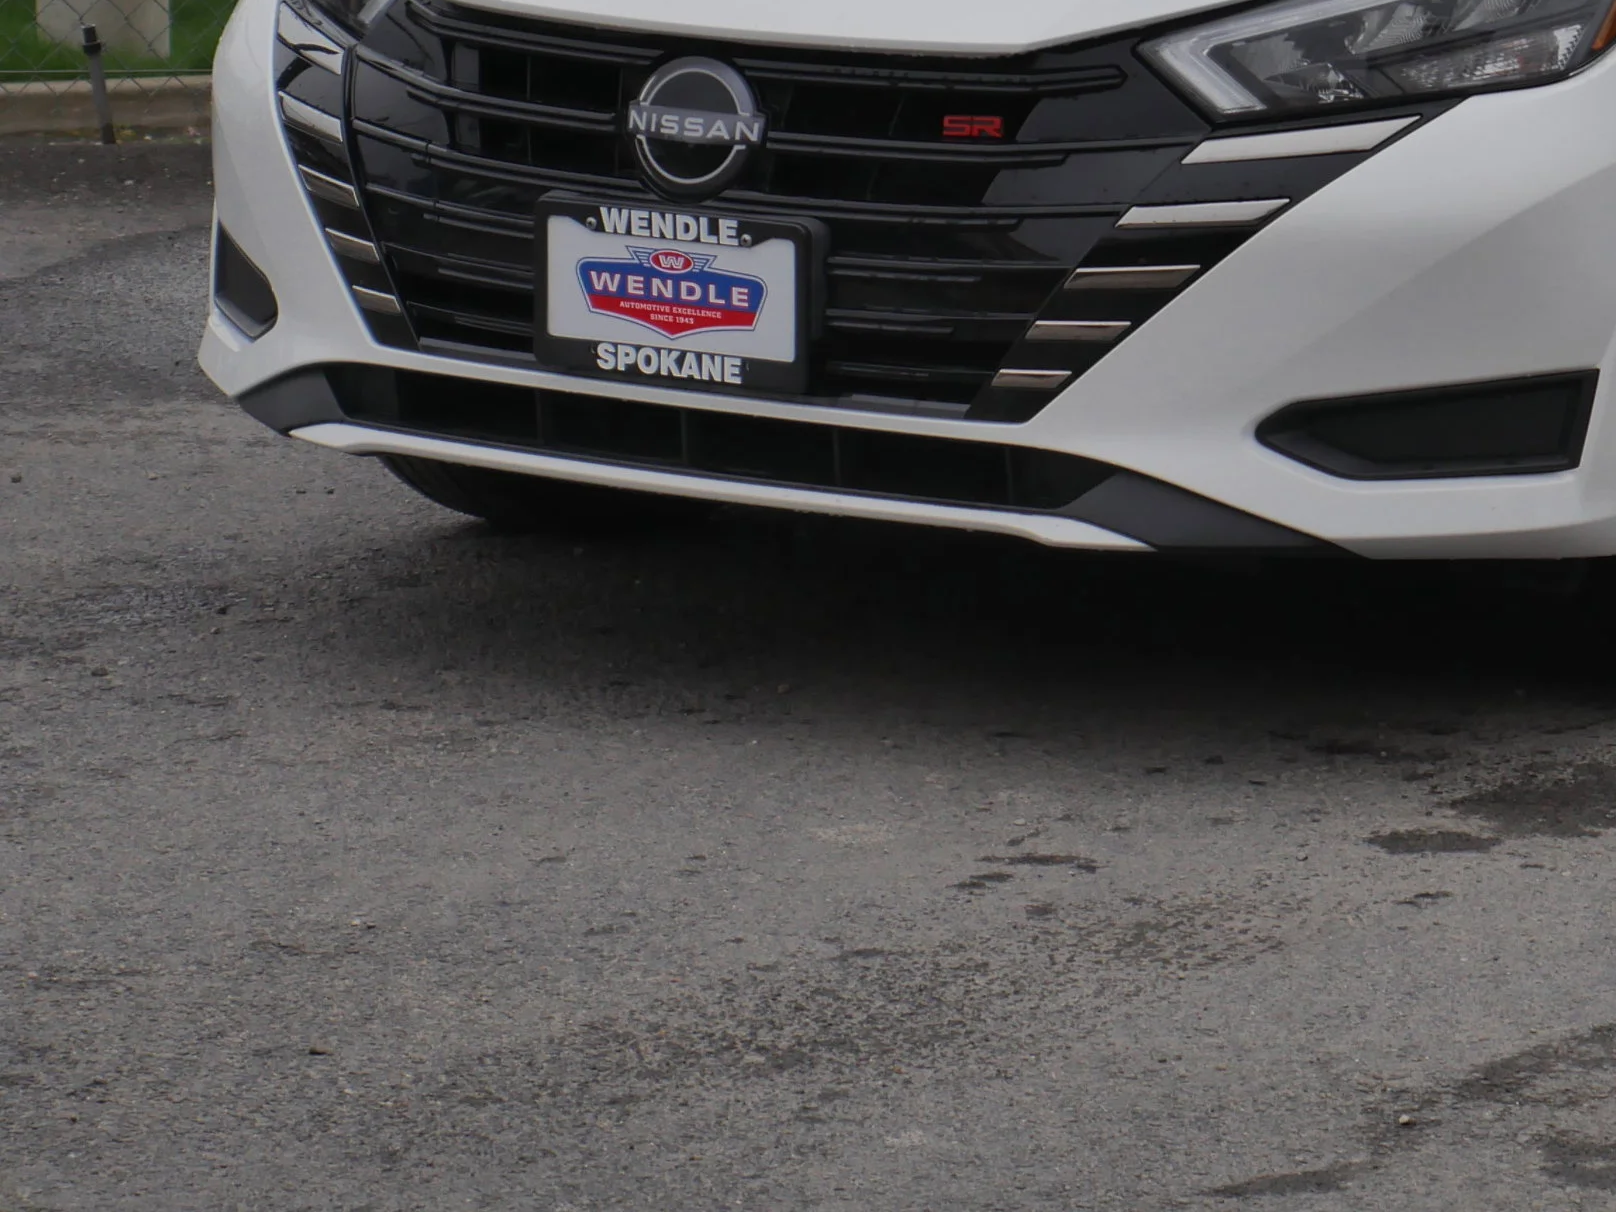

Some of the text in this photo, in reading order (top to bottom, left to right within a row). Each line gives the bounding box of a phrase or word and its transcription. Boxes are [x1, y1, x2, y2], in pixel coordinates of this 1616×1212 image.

[628, 108, 761, 143] NISSAN
[942, 115, 1004, 138] SR
[600, 206, 740, 247] WENDLE
[590, 270, 749, 307] WENDLE
[619, 301, 722, 319] AUTOMOTIVE EXCELLENCE
[650, 313, 694, 325] SINCE 1943
[596, 342, 743, 384] SPOKANE
